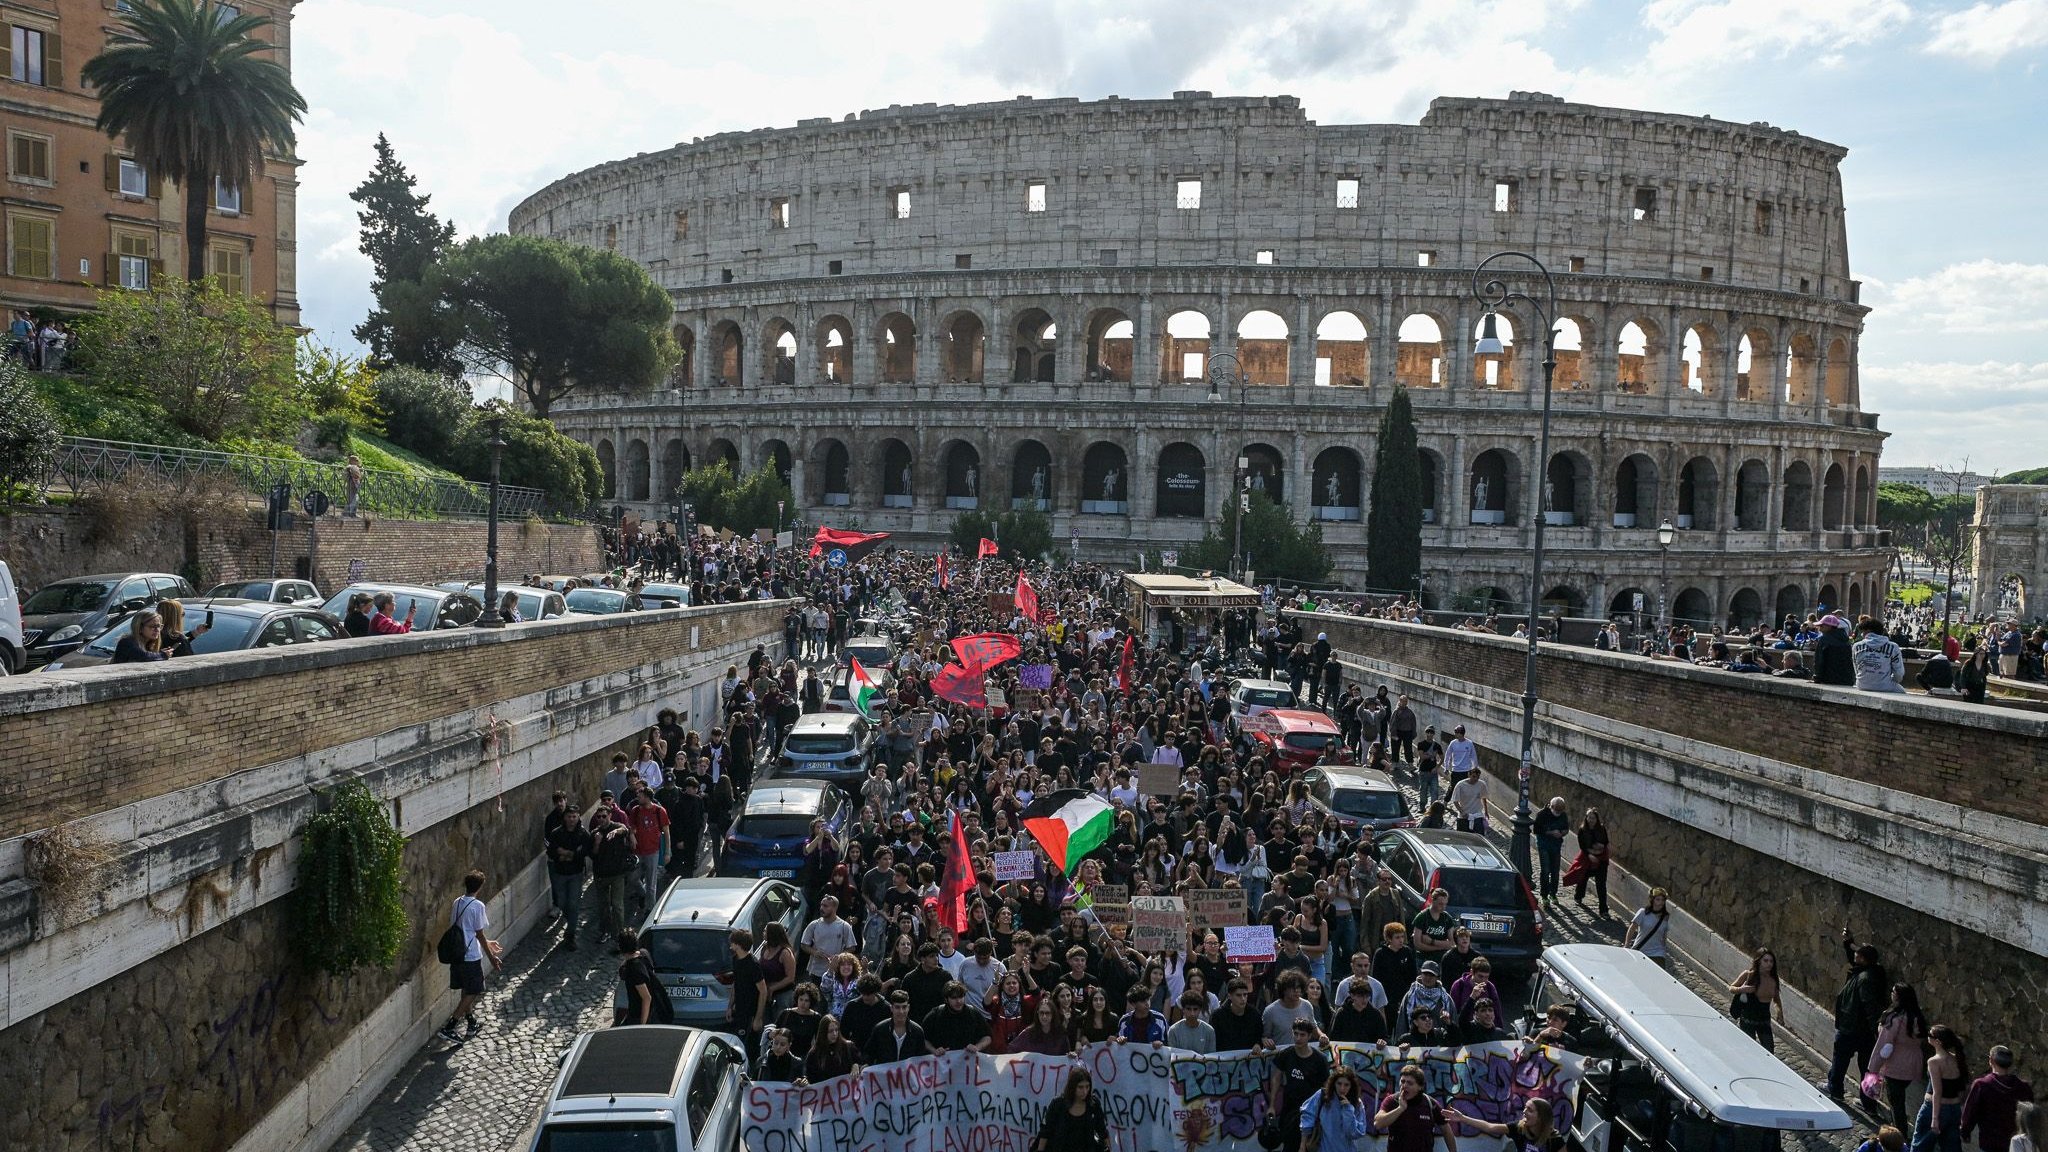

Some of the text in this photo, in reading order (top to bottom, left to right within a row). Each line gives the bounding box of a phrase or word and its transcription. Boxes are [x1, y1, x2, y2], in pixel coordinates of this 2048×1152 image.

[1160, 899, 1176, 912] LA
[1471, 921, 1480, 929] DS
[1009, 1048, 1117, 1096] FUTO
[744, 1116, 867, 1152] CONTRO
